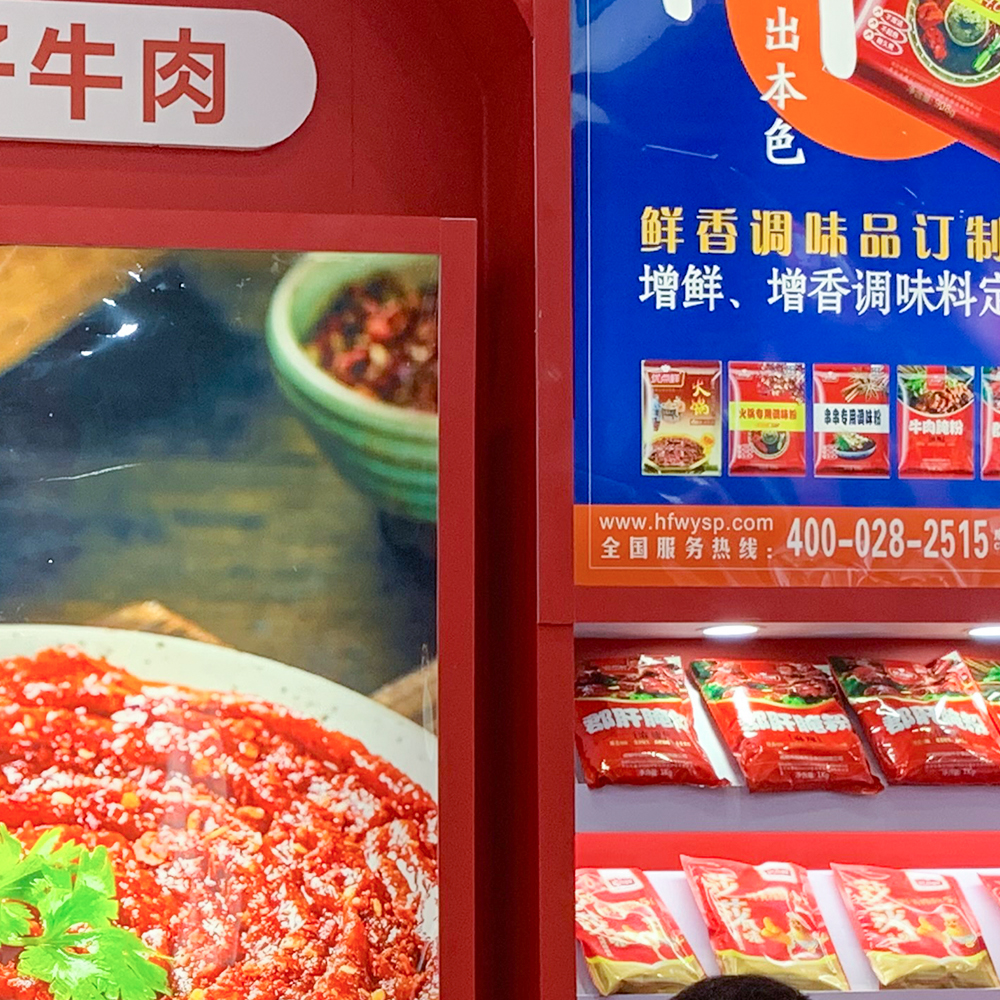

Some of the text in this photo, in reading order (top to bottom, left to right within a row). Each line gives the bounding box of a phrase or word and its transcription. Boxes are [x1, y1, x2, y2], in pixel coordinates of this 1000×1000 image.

[760, 6, 807, 166] 出本色
[640, 206, 1000, 263] 鲜香调味品订制
[599, 512, 774, 535] www.hfwysp.com
[787, 517, 989, 559] 400-028-2515
